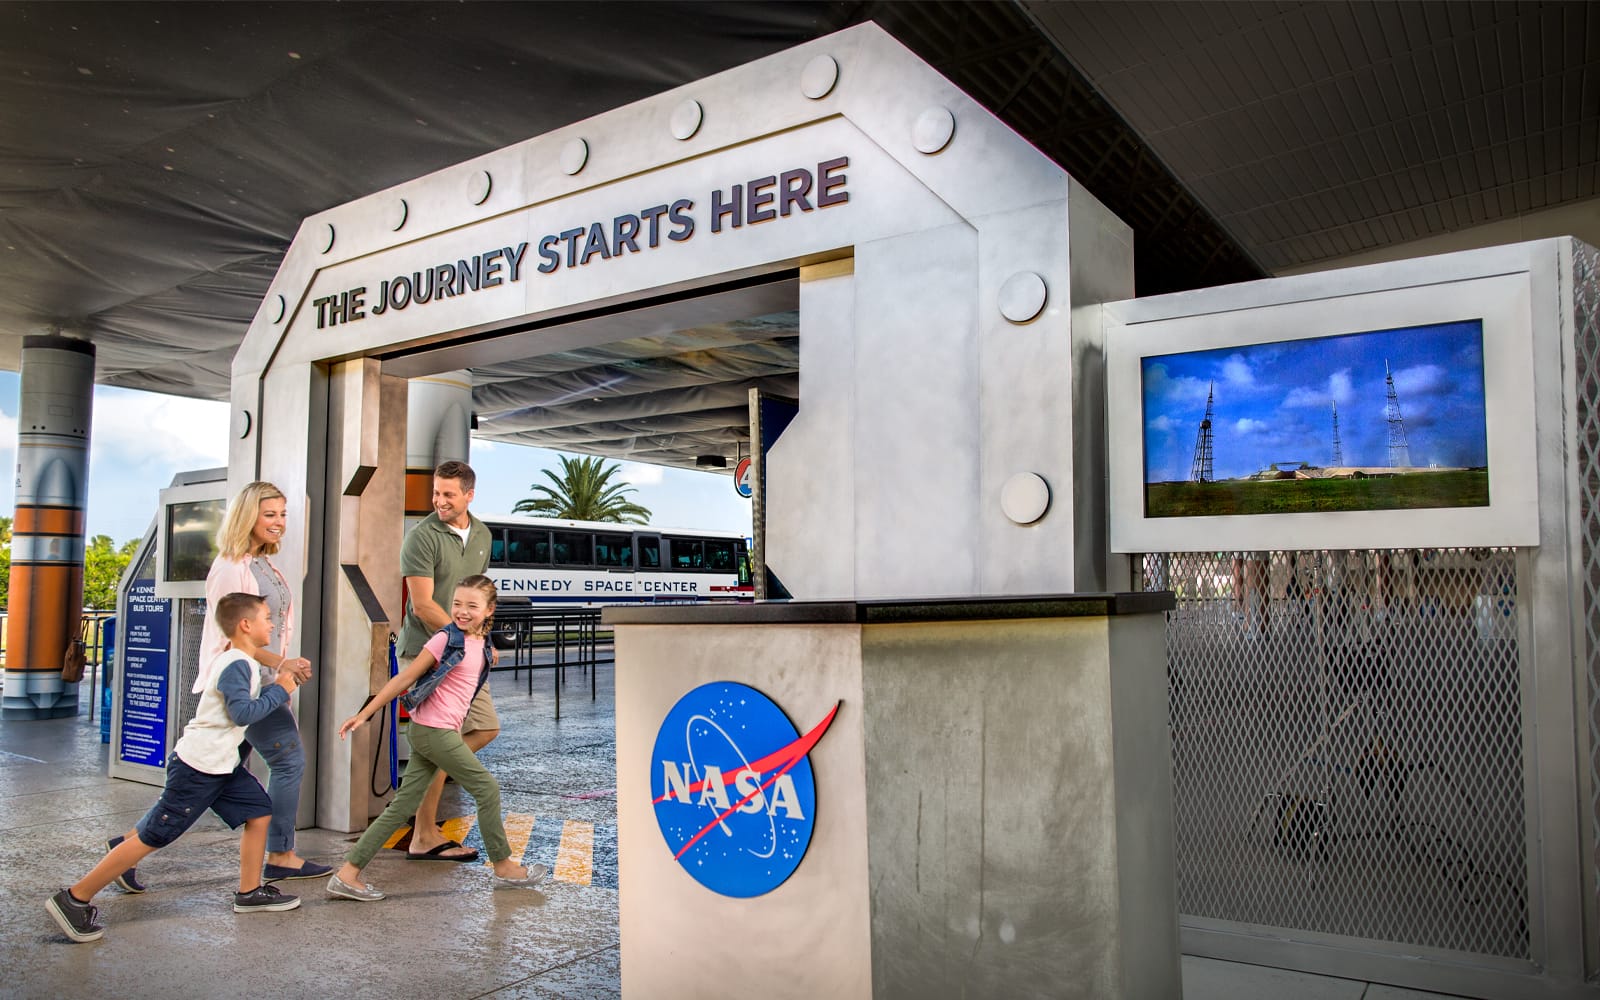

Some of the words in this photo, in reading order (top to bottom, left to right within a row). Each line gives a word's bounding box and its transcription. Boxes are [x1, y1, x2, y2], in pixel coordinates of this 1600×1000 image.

[313, 287, 366, 329] THE
[372, 241, 529, 315] JOURNEY
[537, 199, 694, 274] STARTS
[711, 156, 849, 234] HERE
[584, 580, 633, 592] SPACE
[644, 581, 698, 592] CENTER
[129, 595, 146, 603] SPACE
[133, 604, 145, 612] BUS
[145, 604, 164, 612] TOURS
[662, 760, 806, 821] NASA
